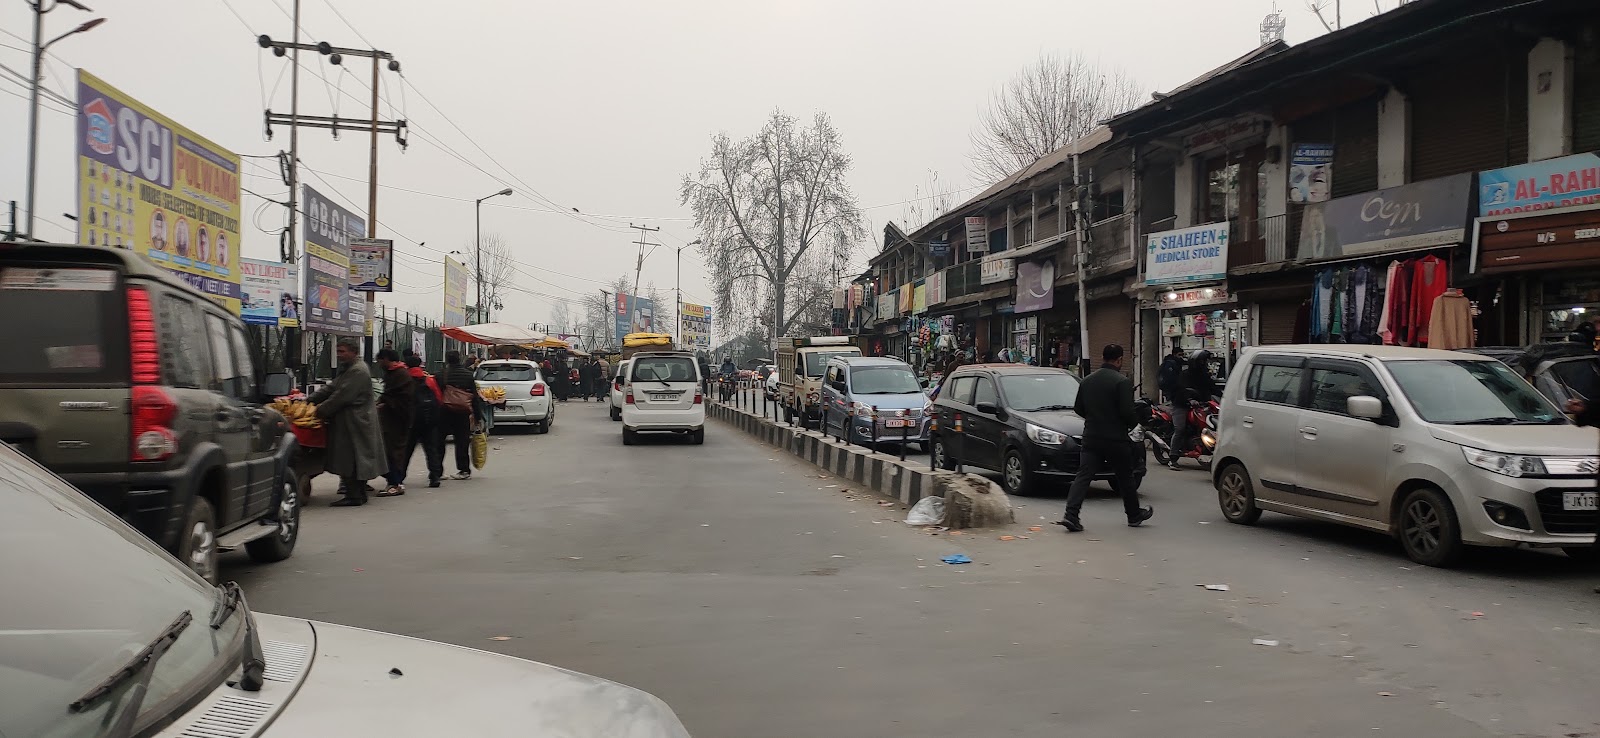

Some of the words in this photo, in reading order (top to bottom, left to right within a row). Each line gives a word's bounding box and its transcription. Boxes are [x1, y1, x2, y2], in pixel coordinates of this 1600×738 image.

[116, 107, 171, 187] SCI
[176, 149, 239, 205] PULWAMA
[1515, 167, 1600, 201] AL-RAH
[1160, 229, 1217, 250] SHAHEEN
[1537, 232, 1556, 244] M/S
[1155, 249, 1190, 263] MEDICAL
[1192, 246, 1220, 259] STORE
[240, 262, 256, 276] SKY
[259, 264, 288, 279] LIGHT
[206, 279, 218, 293] NEET
